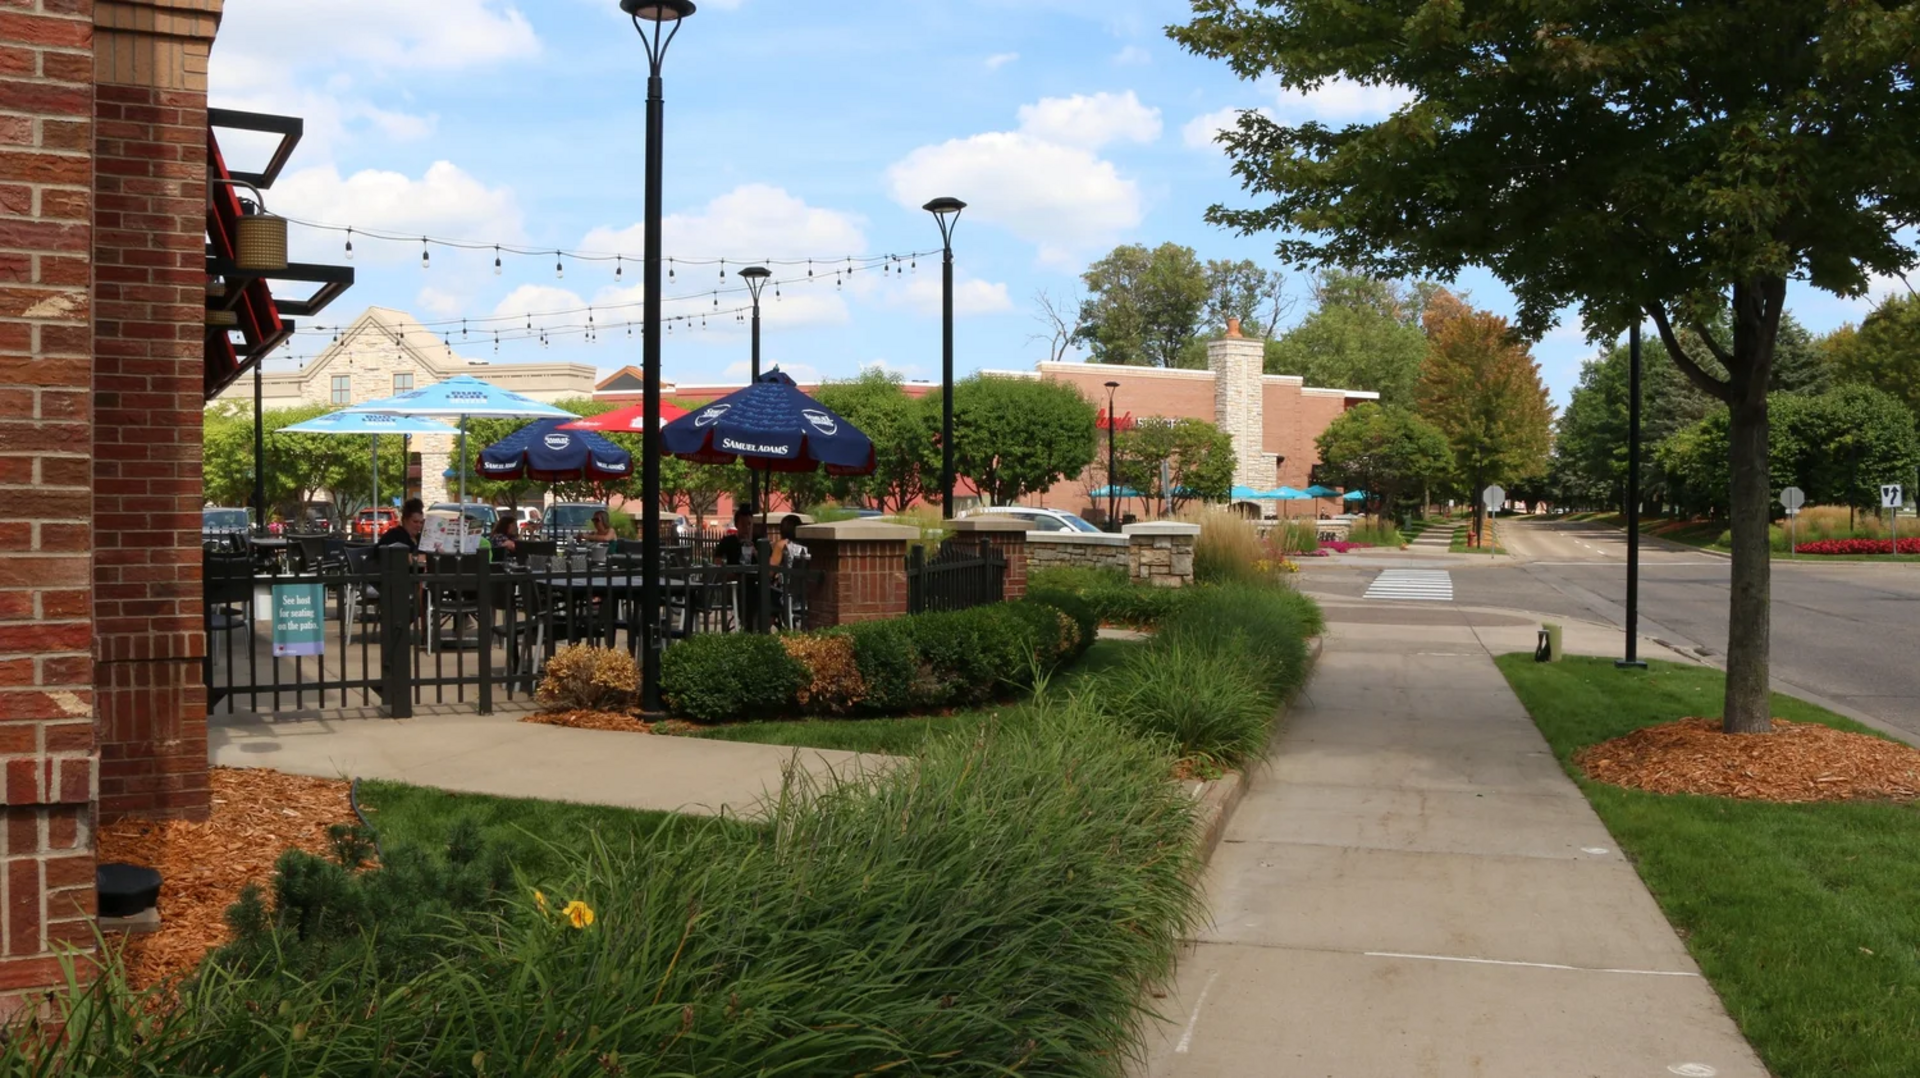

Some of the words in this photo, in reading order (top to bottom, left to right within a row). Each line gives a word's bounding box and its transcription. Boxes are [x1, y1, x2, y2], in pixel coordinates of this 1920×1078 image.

[722, 437, 756, 452] SAMUEL
[757, 444, 789, 455] ADAMS
[282, 595, 294, 605] See
[296, 595, 311, 605] host
[279, 608, 289, 617] for
[291, 608, 314, 618] seating
[287, 620, 298, 630] the
